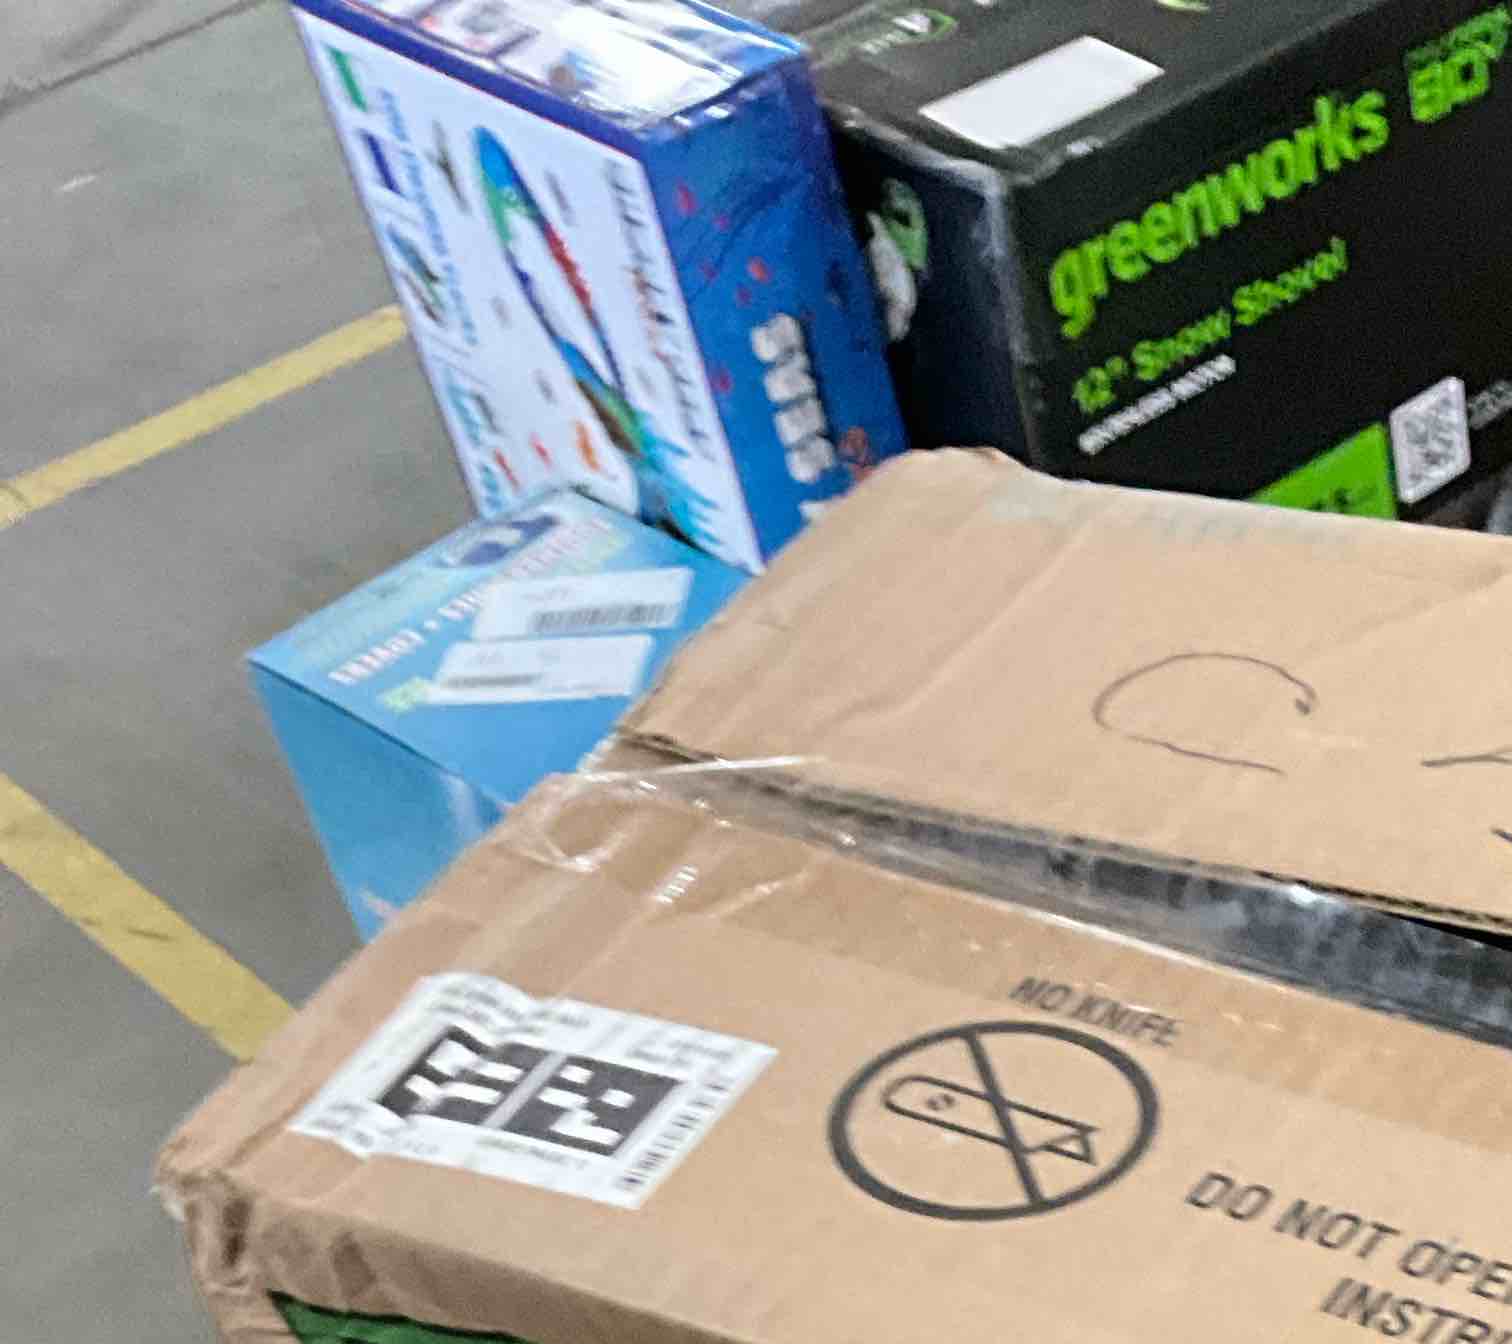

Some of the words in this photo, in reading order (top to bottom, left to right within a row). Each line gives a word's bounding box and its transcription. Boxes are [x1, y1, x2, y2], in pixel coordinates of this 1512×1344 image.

[1051, 90, 1389, 337] greenworks
[1232, 236, 1348, 325] Shovel
[1009, 976, 1071, 1012] NO
[1070, 993, 1184, 1049] KNIFE
[1184, 1171, 1272, 1221] DO
[1273, 1199, 1405, 1261] NOT
